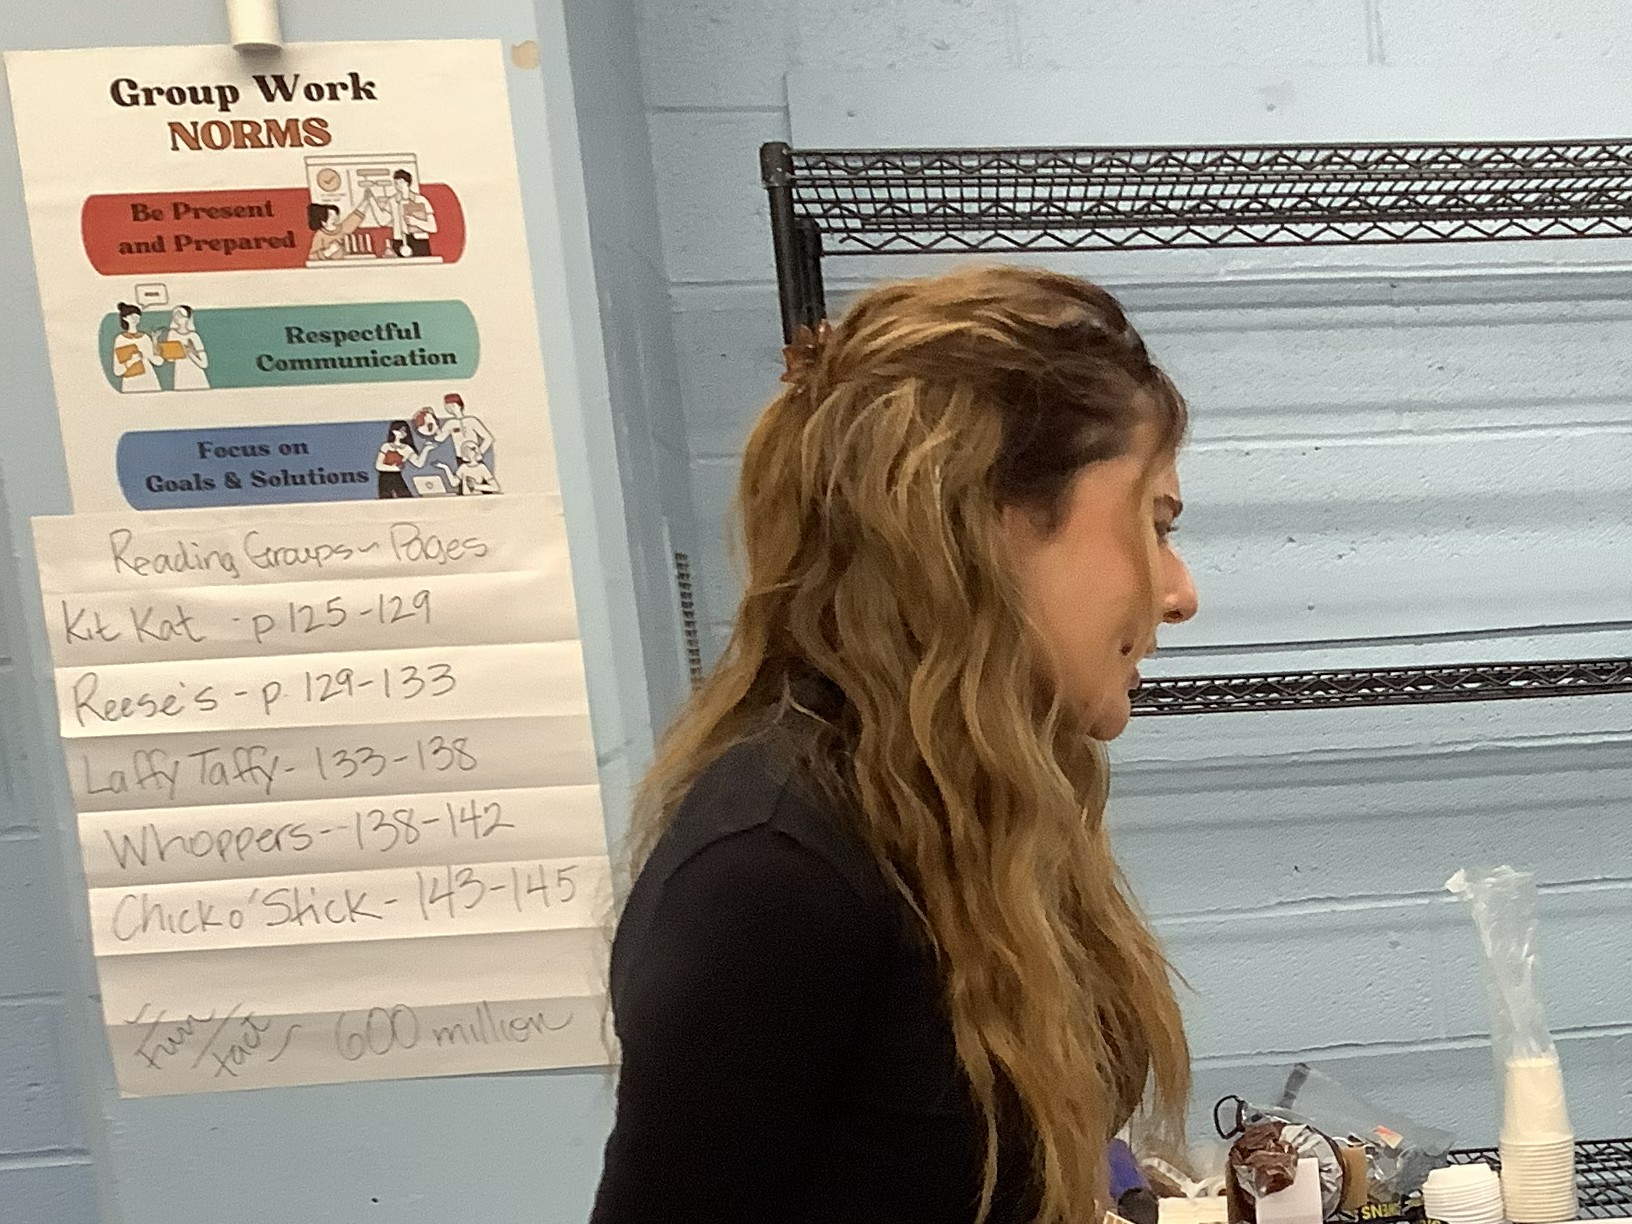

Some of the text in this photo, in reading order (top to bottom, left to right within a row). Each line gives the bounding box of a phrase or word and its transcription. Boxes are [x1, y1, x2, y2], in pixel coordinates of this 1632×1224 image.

[110, 72, 377, 111] Group Work
[168, 117, 332, 151] NORMS
[131, 200, 275, 223] Be Present
[118, 231, 298, 257] and Prepared
[284, 322, 422, 349] Respectful
[255, 347, 458, 372] Communication
[197, 440, 309, 462] Focus on
[145, 466, 370, 494] Goals & Solutions
[109, 528, 240, 578] Reading
[390, 521, 488, 565] Pages
[62, 600, 122, 644] Kit
[130, 604, 206, 643] Kat
[72, 671, 218, 727] Reese's
[306, 663, 456, 702] 129-133
[83, 748, 179, 800] Laffy
[315, 735, 478, 780] 133-138
[356, 799, 515, 852] 138-142
[416, 864, 578, 921] 143-145
[334, 1003, 419, 1061] 600
[432, 1000, 574, 1047] million
